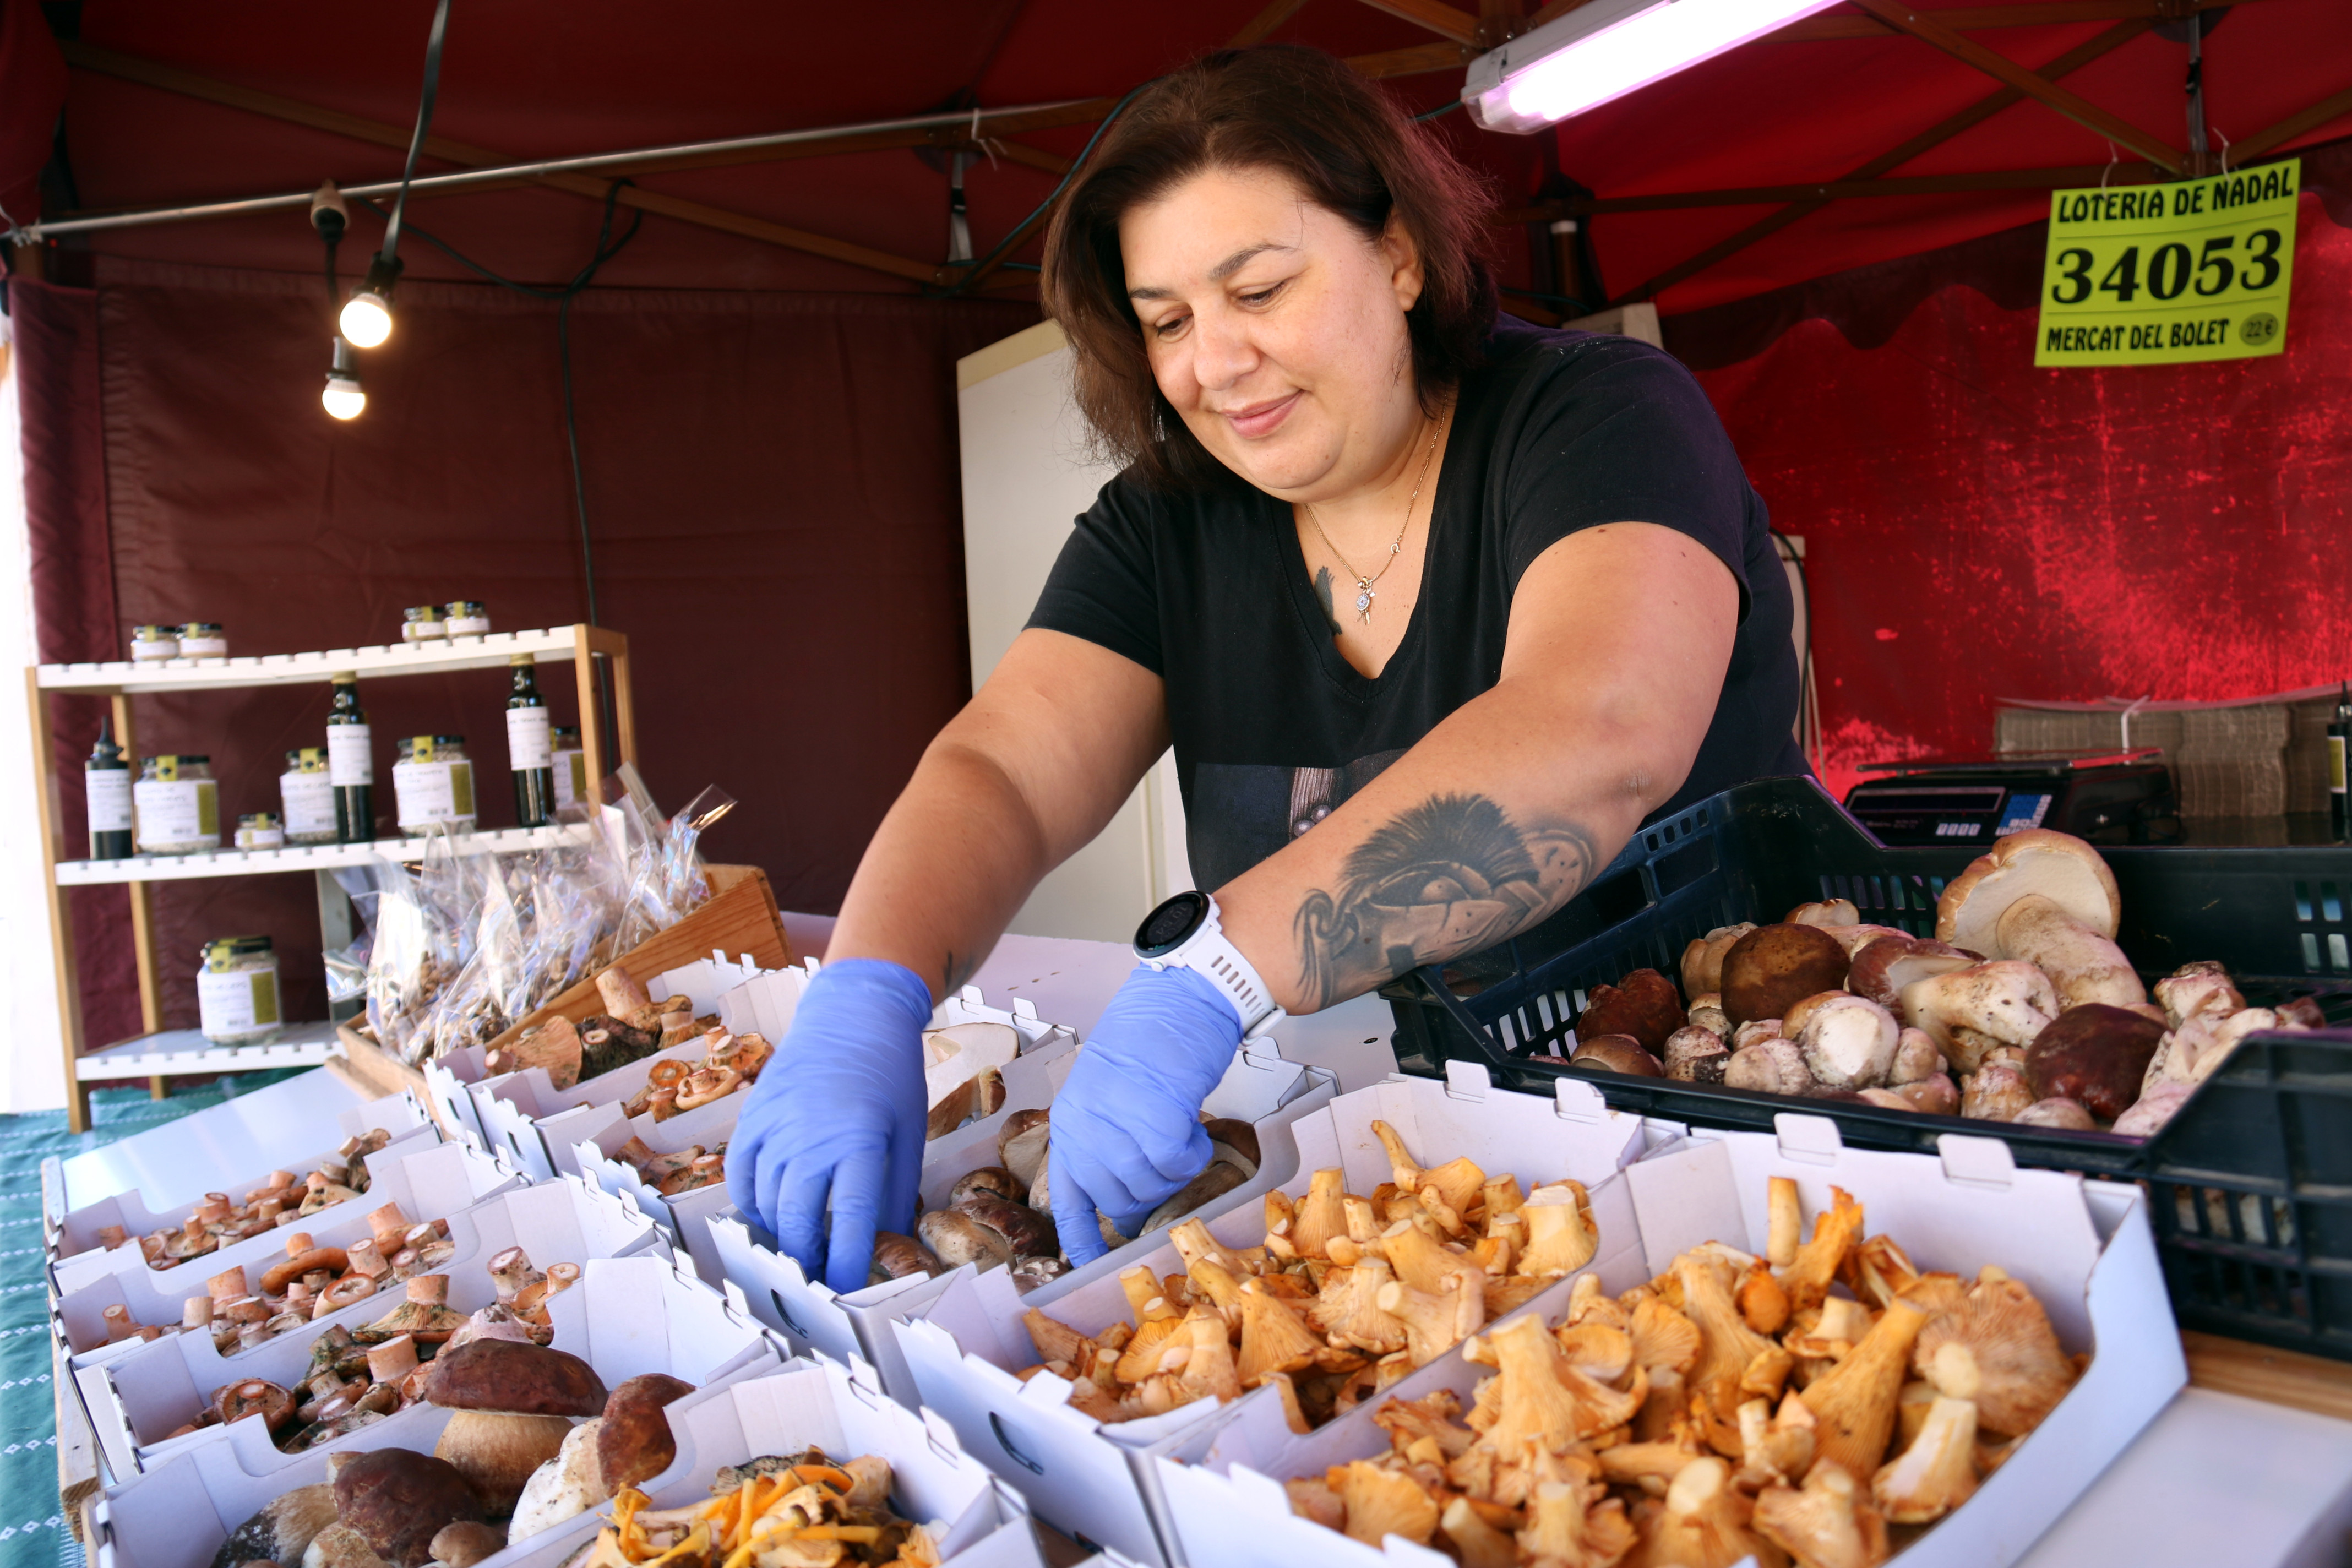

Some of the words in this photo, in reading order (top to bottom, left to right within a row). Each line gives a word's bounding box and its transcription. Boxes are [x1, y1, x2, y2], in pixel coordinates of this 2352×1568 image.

[2059, 190, 2164, 222] LOTERIA
[2174, 184, 2206, 216] DE
[2212, 167, 2293, 211] NADAL
[2052, 228, 2282, 304] 34053
[2046, 326, 2125, 351] MERCAT
[2129, 324, 2163, 350] DEL
[2170, 318, 2230, 347] BOLET
[2246, 321, 2262, 337] 22
[2265, 319, 2273, 335] €
